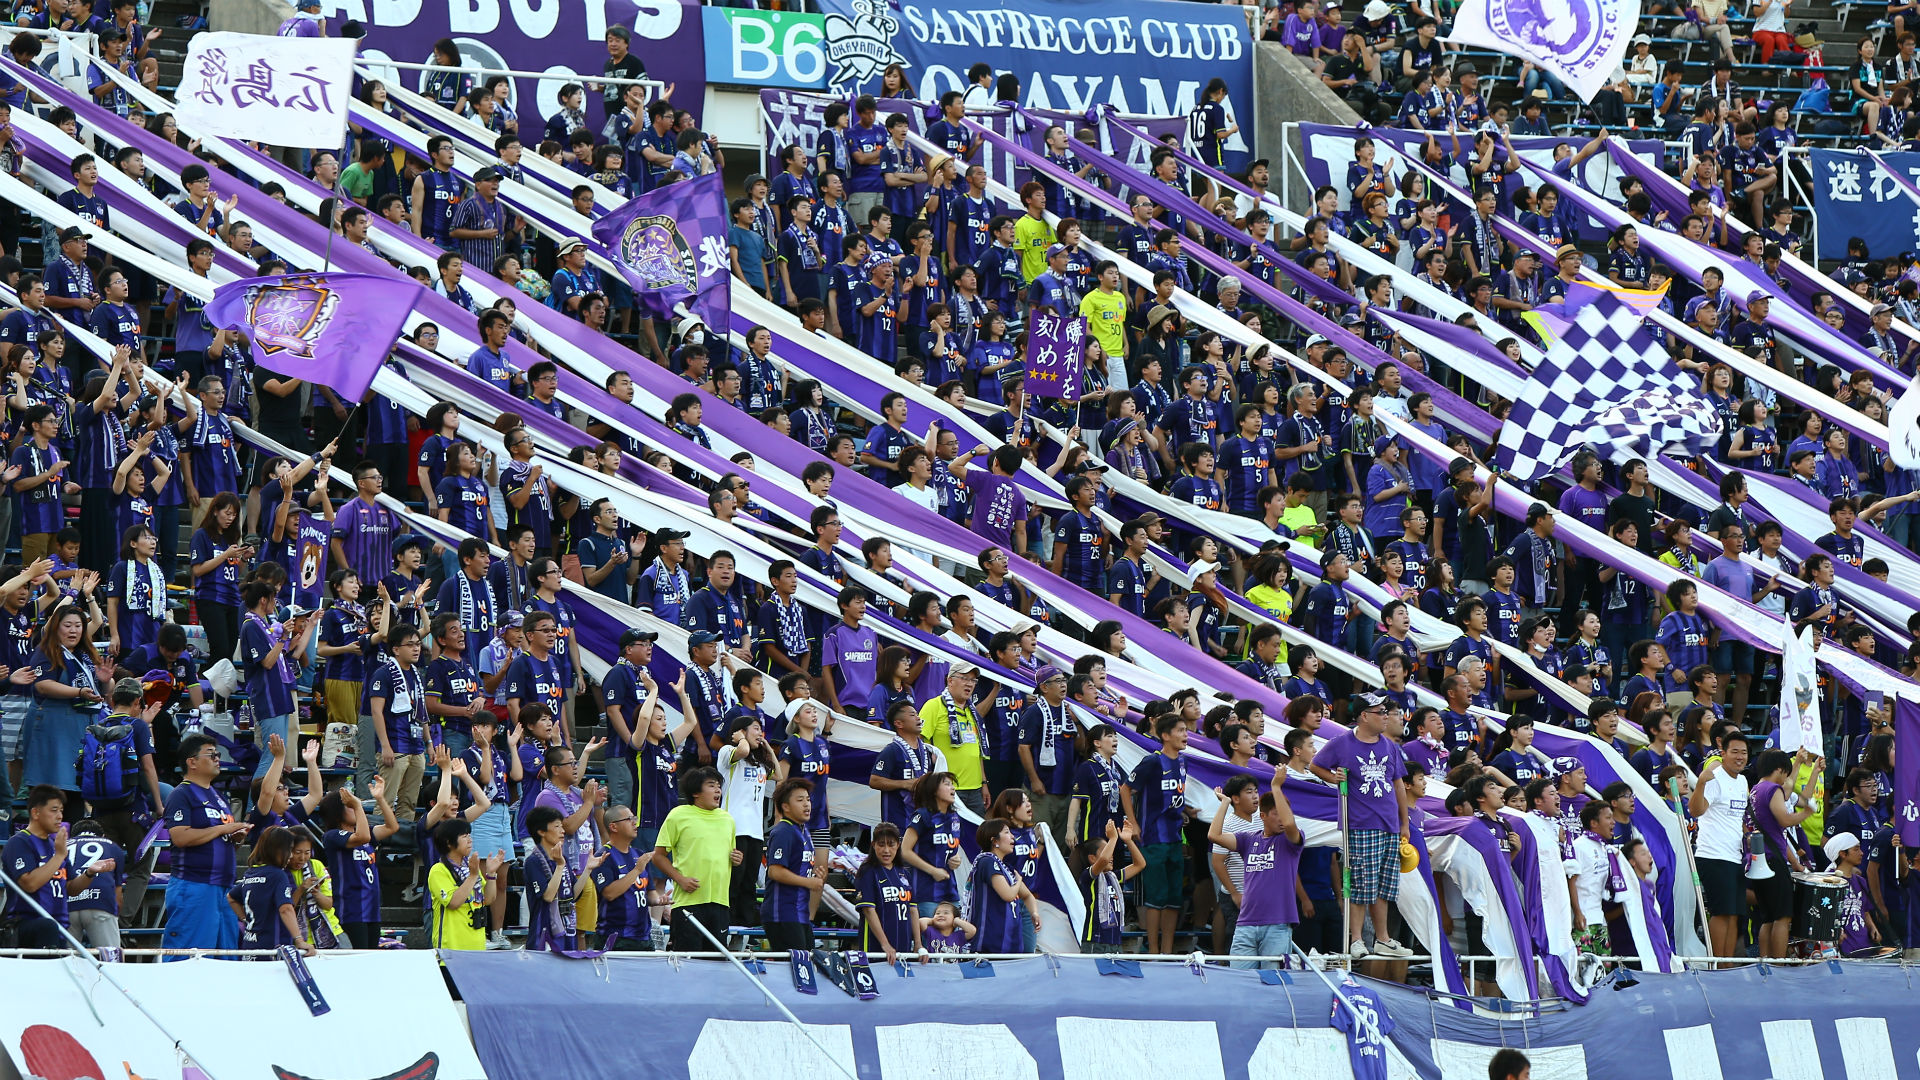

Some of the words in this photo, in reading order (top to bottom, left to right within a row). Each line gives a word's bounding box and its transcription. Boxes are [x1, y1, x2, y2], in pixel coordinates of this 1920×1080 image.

[904, 5, 1137, 56] SANFRECCE
[1140, 18, 1243, 61] CLUB
[732, 16, 826, 83] B6
[832, 39, 885, 59] OKAYAMA
[919, 64, 1250, 153] OAYAMA
[1192, 111, 1206, 138] 16
[1827, 160, 1920, 204] 迷わ
[445, 204, 453, 218] 6
[1175, 211, 1183, 224] 6
[974, 232, 987, 246] 50
[1262, 266, 1269, 280] 6
[1076, 276, 1087, 290] 14
[881, 317, 892, 332] 12
[1111, 323, 1122, 337] 50
[133, 335, 140, 351] 3
[1034, 314, 1059, 368] 刻め
[1376, 339, 1388, 353] 50
[1063, 321, 1086, 400] 勝利を
[1340, 408, 1347, 422] 6
[628, 437, 639, 452] 14
[223, 450, 229, 464] 5
[1241, 456, 1270, 469] EDION
[1761, 453, 1771, 468] 16
[1255, 469, 1263, 483] 5
[461, 491, 488, 506] EDION
[954, 488, 967, 504] 50
[1193, 495, 1220, 510] EDION
[476, 506, 482, 520] 6
[1090, 546, 1101, 560] 25
[223, 566, 235, 582] 33
[1413, 575, 1427, 590] 50
[1624, 580, 1636, 595] 12
[480, 614, 488, 632] 8
[1508, 624, 1520, 638] 33
[553, 638, 566, 656] 18
[535, 682, 563, 698] EDION
[1593, 677, 1601, 692] 8
[546, 698, 559, 715] 33
[995, 695, 1024, 711] EDION
[1006, 710, 1020, 727] 50
[1403, 721, 1410, 736] 6
[743, 766, 768, 784] EDION
[801, 761, 830, 776] EDION
[753, 784, 762, 802] 17
[1168, 794, 1185, 810] 50
[1901, 799, 1920, 823] 心
[932, 833, 960, 849] EDION
[365, 867, 374, 884] 8
[1021, 859, 1037, 878] 40
[50, 879, 64, 899] 12
[882, 886, 912, 902] EDION
[633, 890, 647, 909] 18
[896, 903, 909, 921] 12
[797, 963, 811, 981] 30
